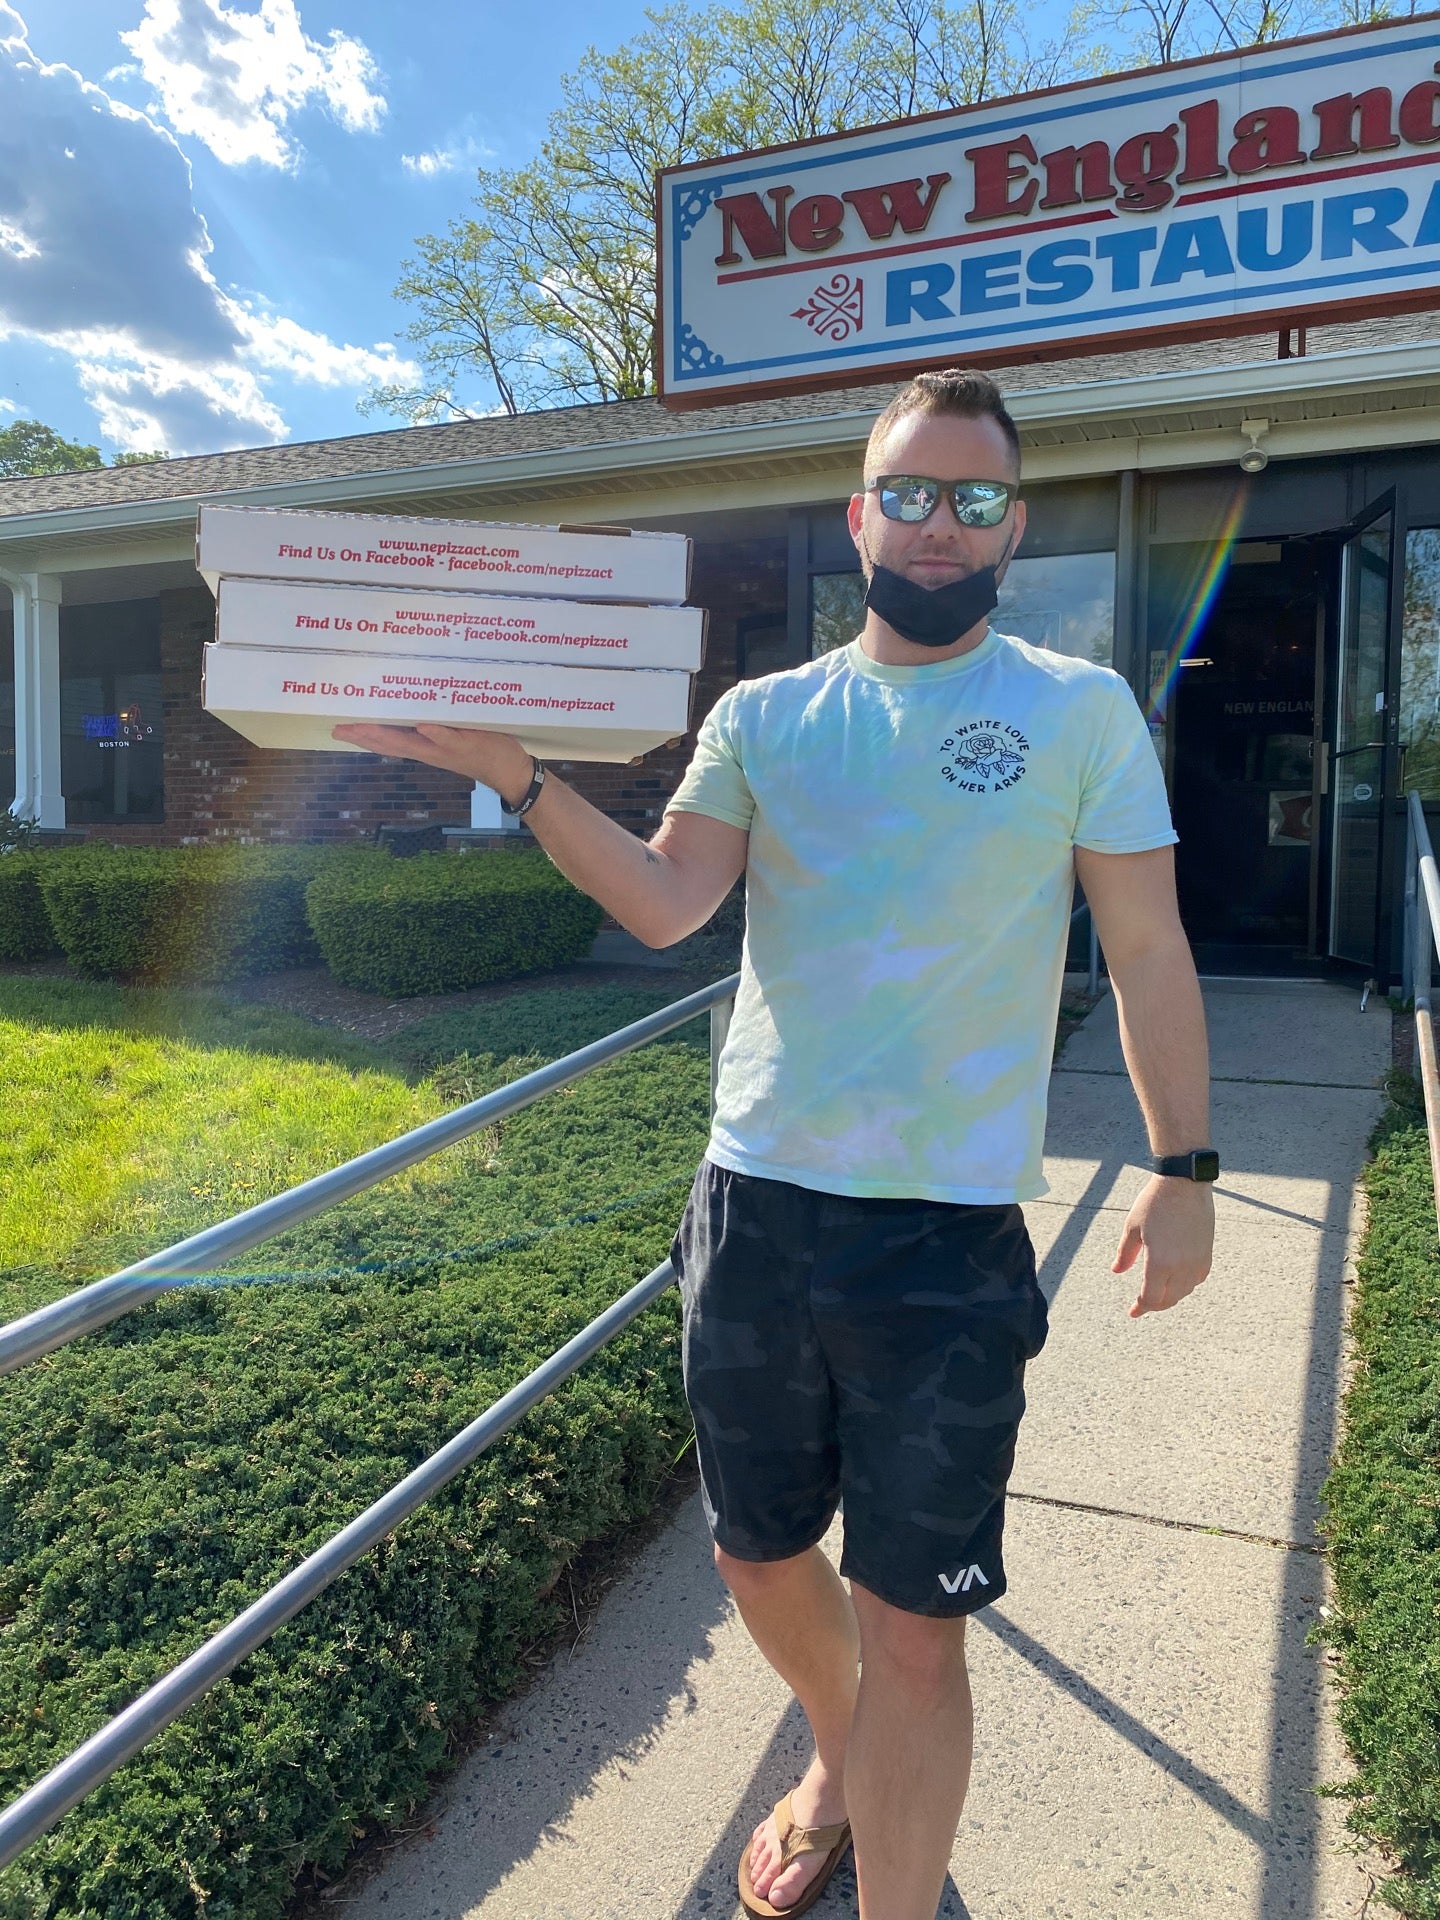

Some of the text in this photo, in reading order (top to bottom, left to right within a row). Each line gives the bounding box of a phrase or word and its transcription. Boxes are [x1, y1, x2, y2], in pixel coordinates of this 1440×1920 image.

[713, 172, 951, 267] New
[278, 544, 312, 559] Find
[317, 546, 336, 561] Us
[340, 549, 362, 563] On
[365, 550, 435, 567] Facebook
[447, 556, 614, 579] facebook.com/nepizzact
[378, 539, 520, 559] www.nepizzact.com
[295, 615, 330, 629] Find
[334, 618, 353, 631] Us
[356, 619, 379, 633] On
[382, 620, 451, 637] Facebook
[464, 627, 629, 649] facebook.com/nepizzact
[395, 610, 536, 629] www.nepizzact.com
[282, 680, 316, 694] Find
[320, 682, 339, 696] Us
[343, 684, 365, 697] On
[368, 685, 438, 701] Facebook
[451, 690, 616, 712] facebook.com/nepizzact
[382, 675, 523, 692] www.nepizzact.com
[1223, 702, 1255, 714] NEW
[99, 740, 130, 748] BOSTON
[939, 720, 1030, 752] TO WRITE LOVE
[941, 765, 1026, 793] ON HER ARMS
